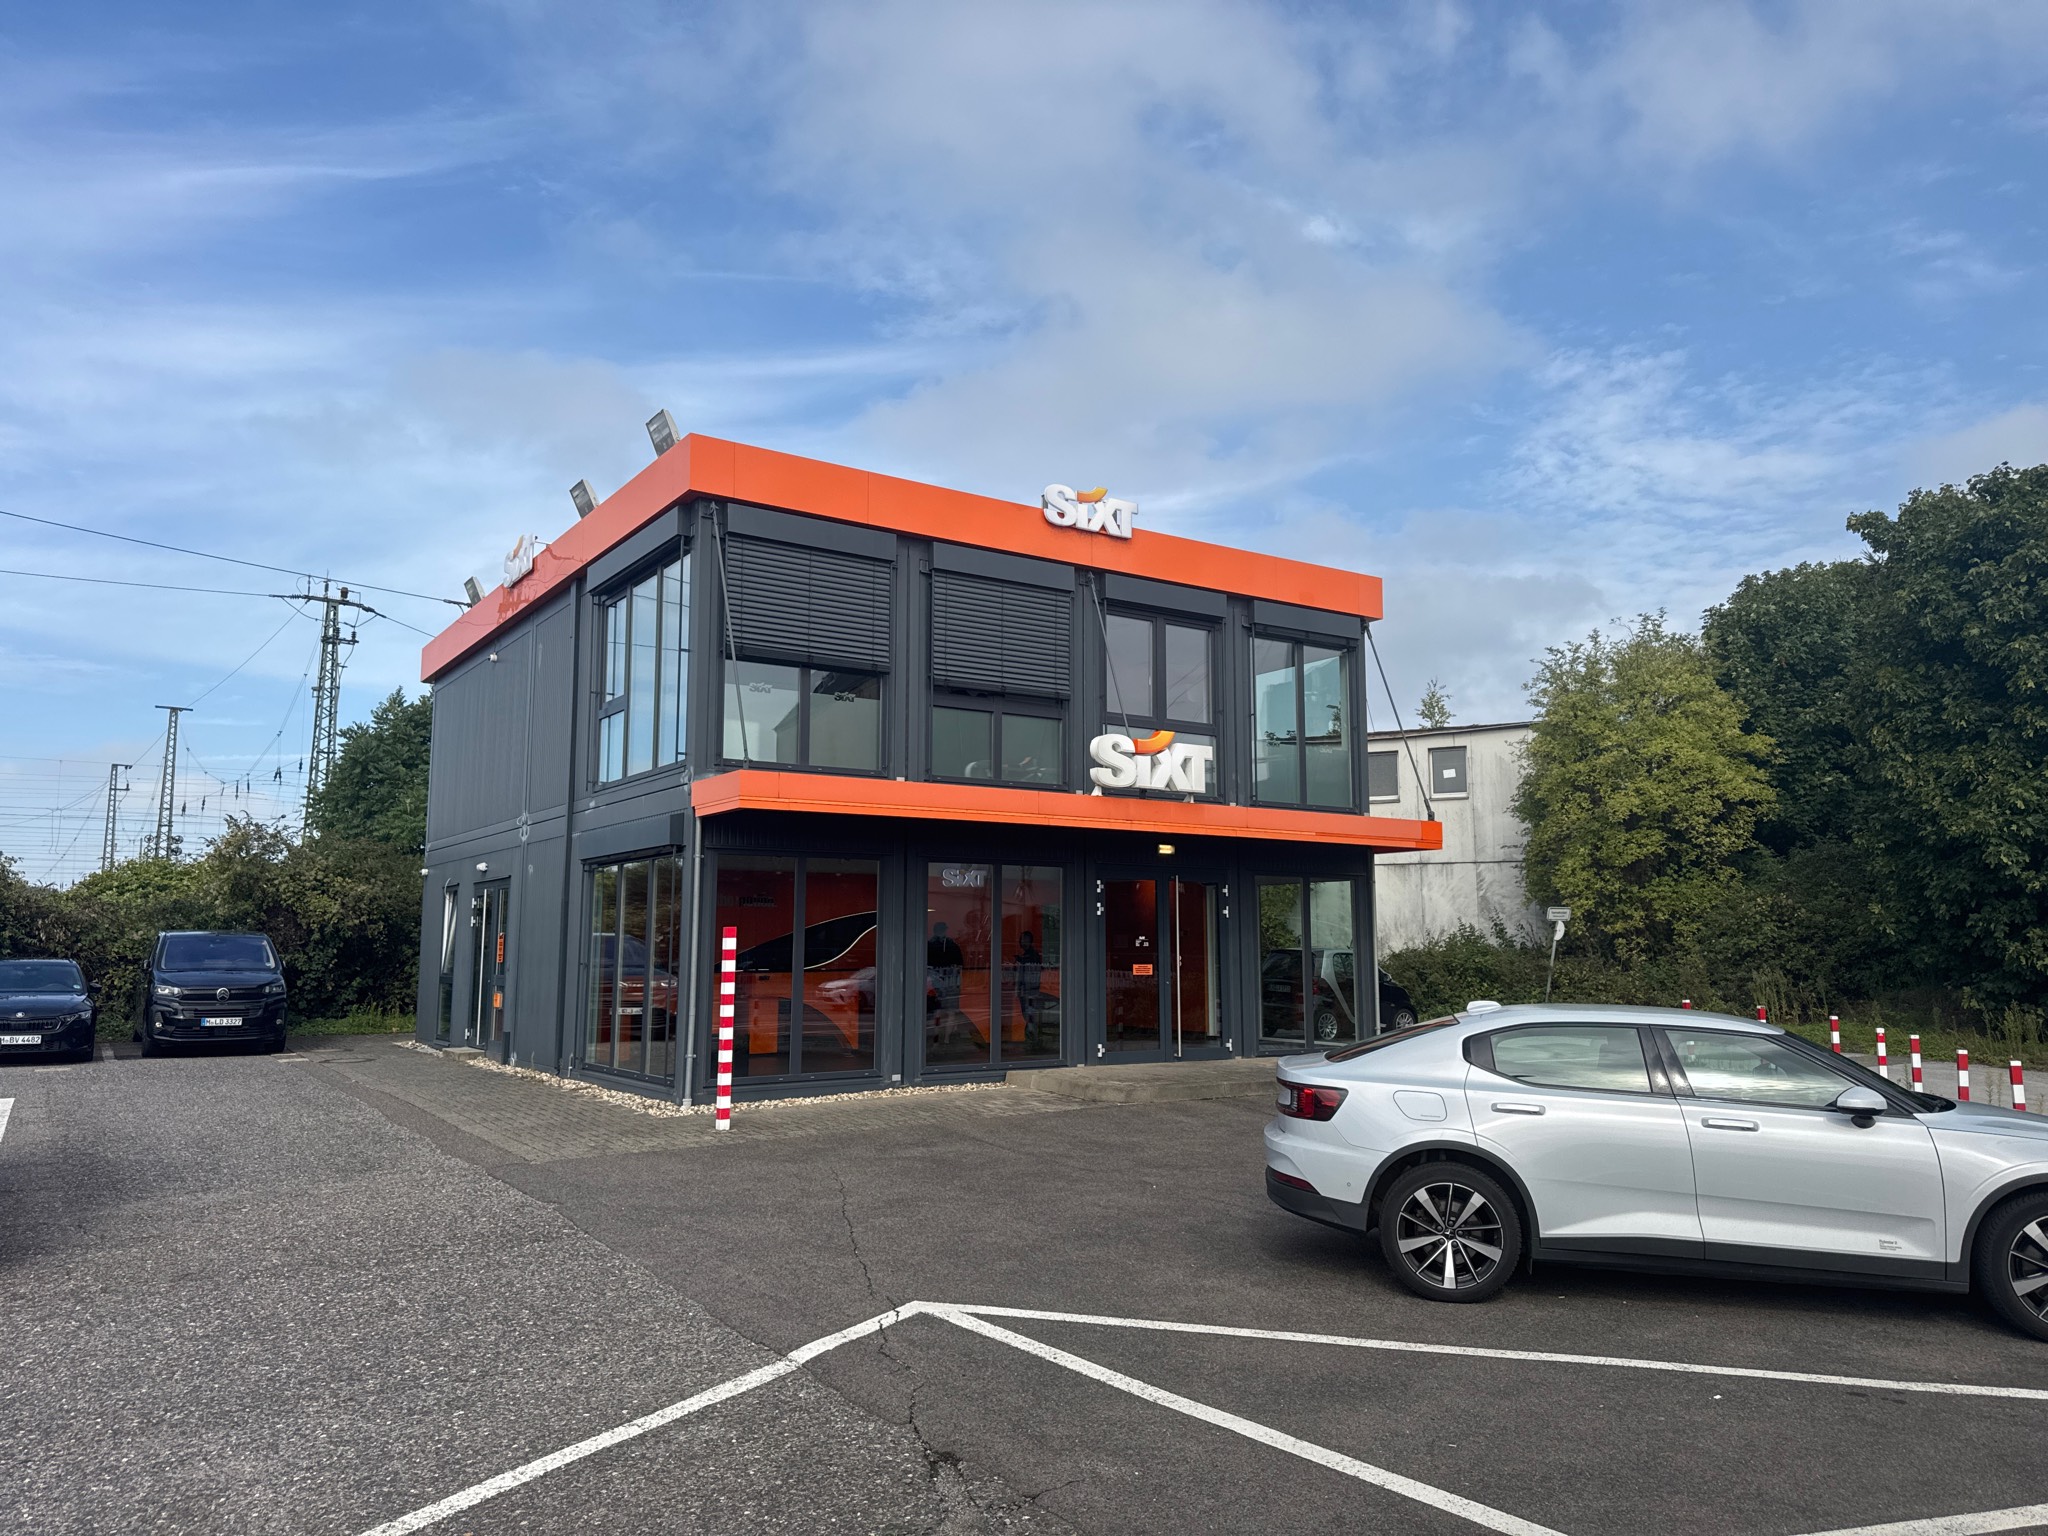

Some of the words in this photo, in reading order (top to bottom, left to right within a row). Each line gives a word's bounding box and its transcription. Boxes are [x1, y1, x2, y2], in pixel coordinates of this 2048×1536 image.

[1043, 483, 1138, 539] SIXT
[1090, 731, 1213, 793] SIXT
[942, 868, 987, 887] SIXT
